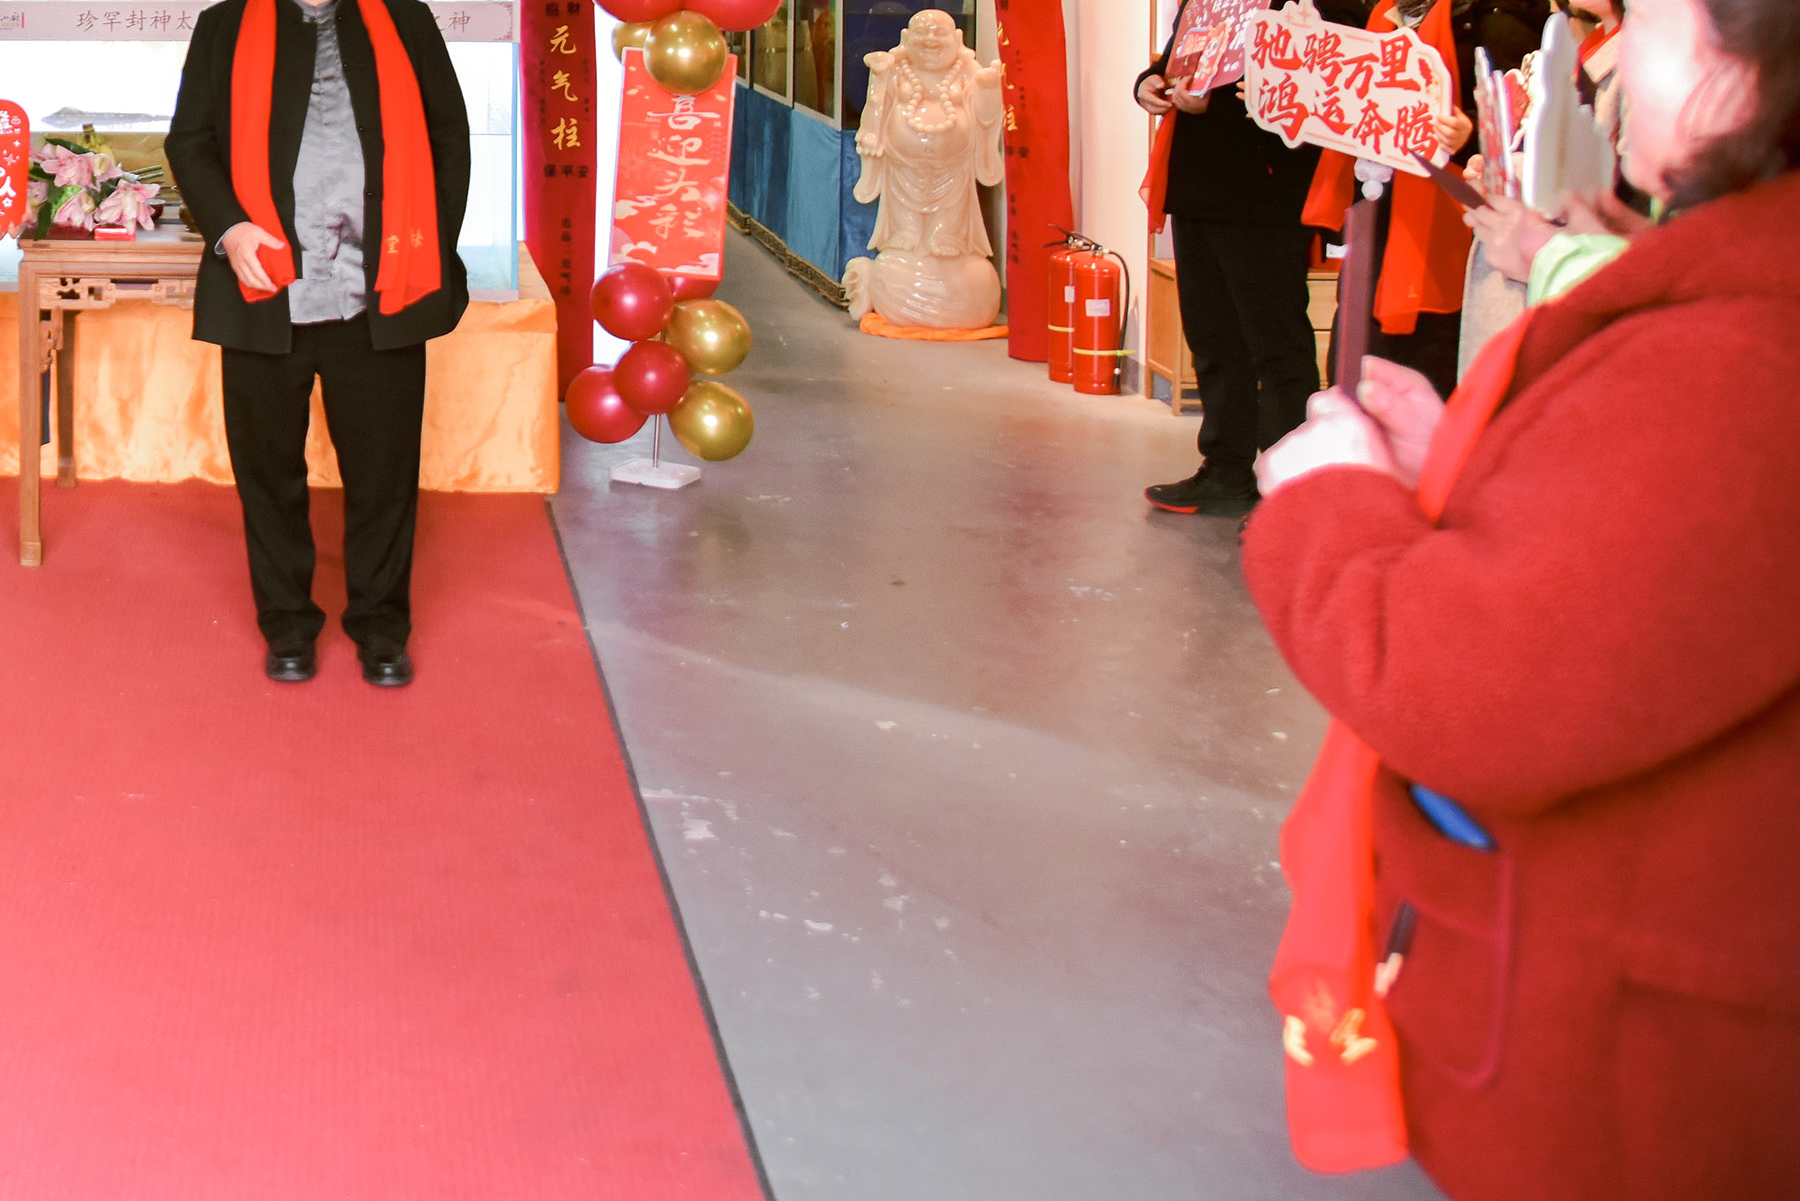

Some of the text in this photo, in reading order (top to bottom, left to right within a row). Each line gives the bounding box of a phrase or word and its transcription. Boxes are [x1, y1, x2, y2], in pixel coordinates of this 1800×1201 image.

[550, 25, 581, 150] 元气柱
[1250, 19, 1422, 98] 驰骋万里
[1257, 72, 1440, 161] 鸿运奔腾
